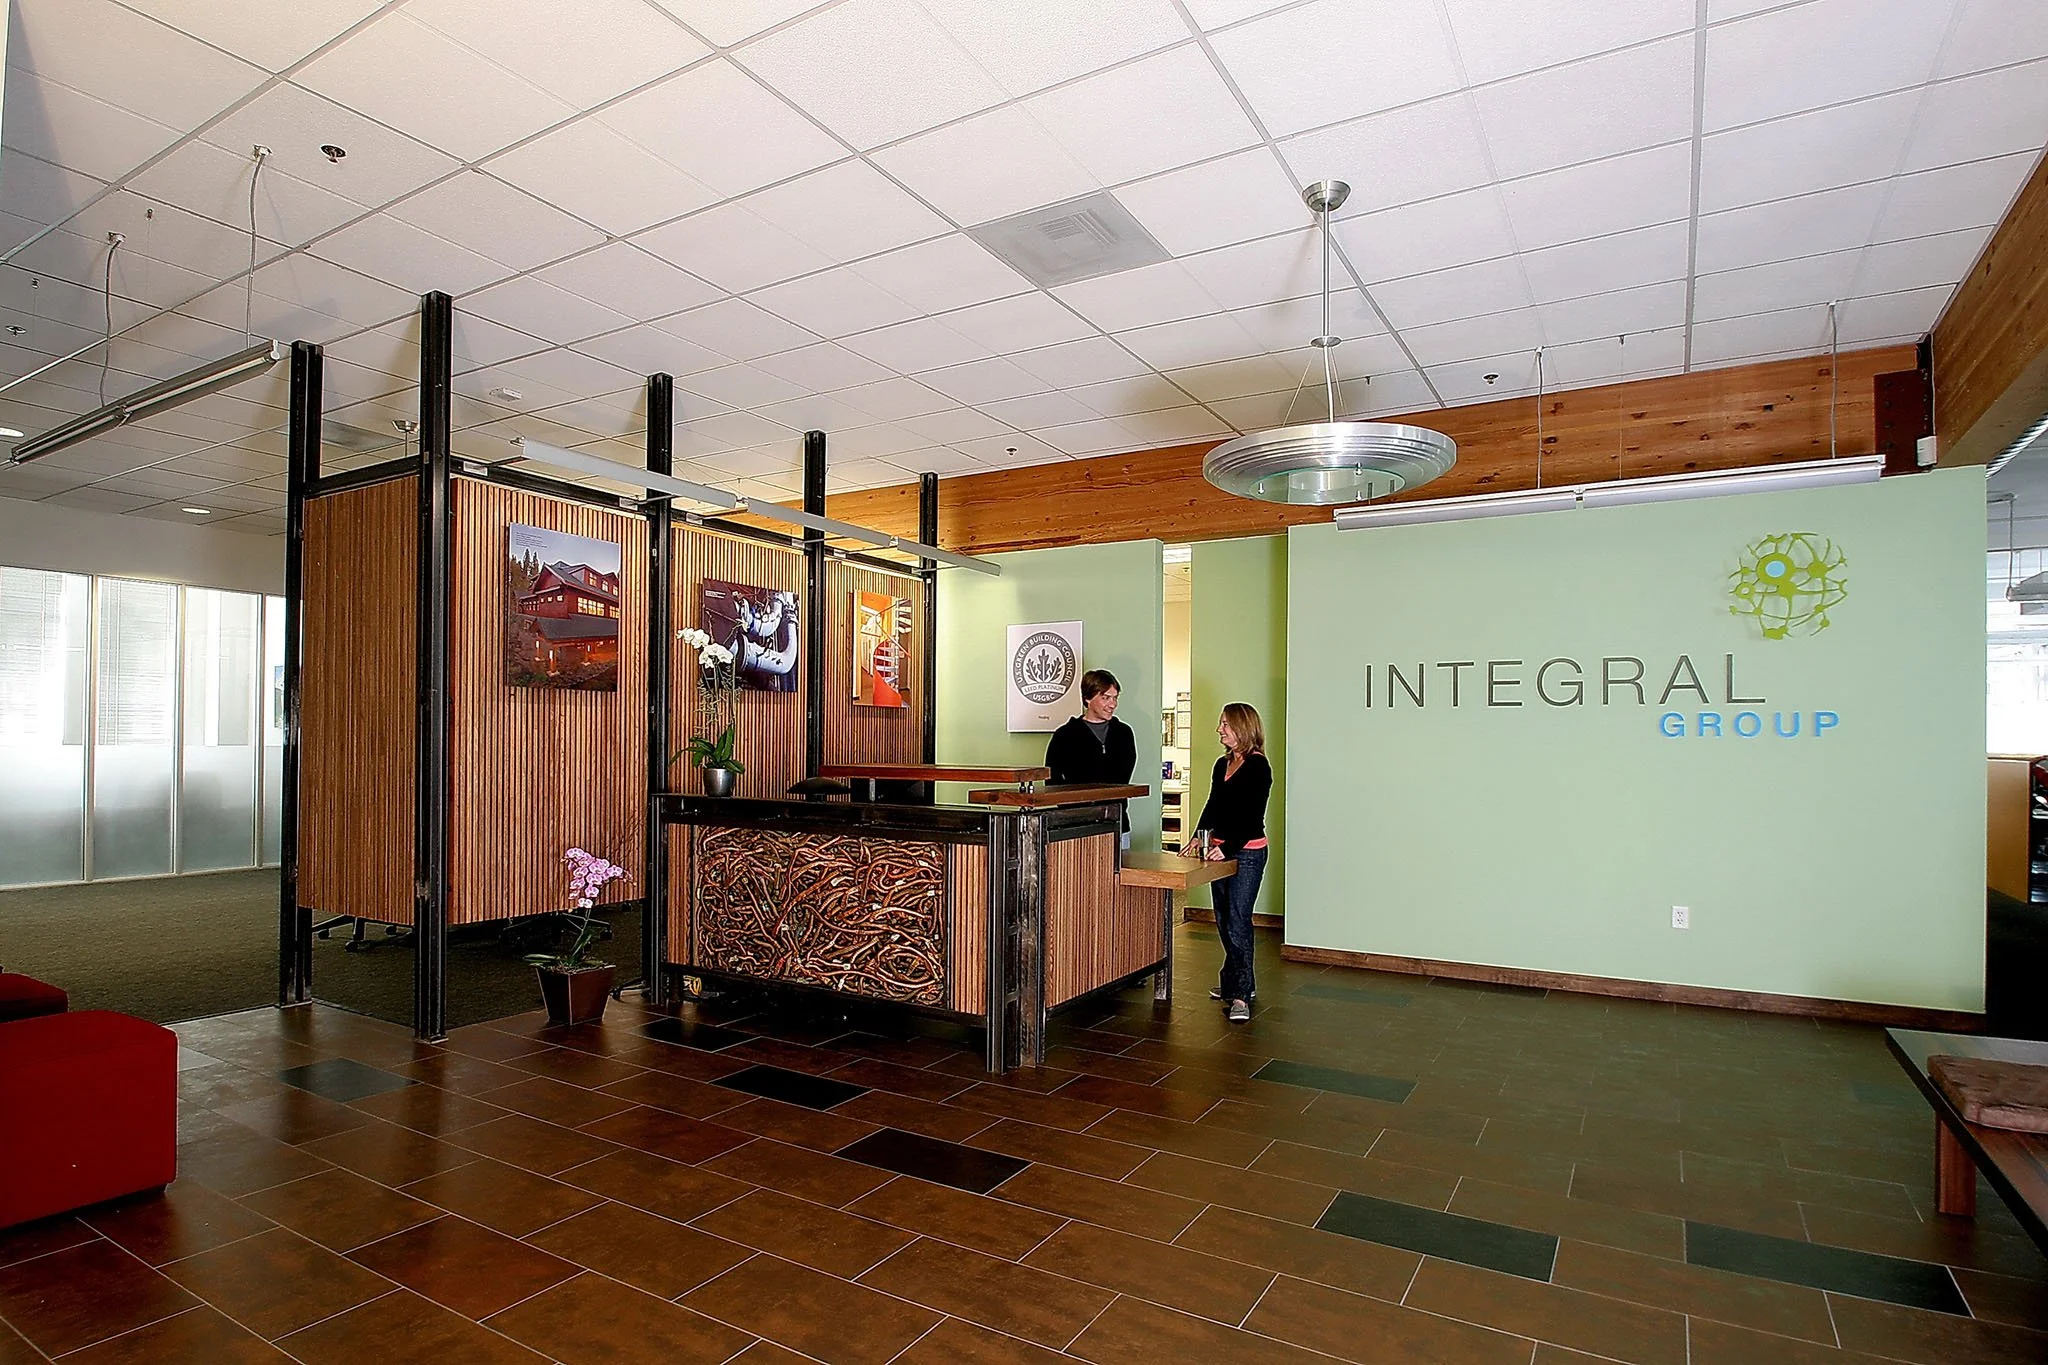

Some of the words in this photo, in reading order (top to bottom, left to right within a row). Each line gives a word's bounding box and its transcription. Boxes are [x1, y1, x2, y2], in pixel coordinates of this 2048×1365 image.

[1015, 643, 1029, 668] GREEN
[1029, 634, 1063, 646] BUILDING
[1062, 645, 1073, 682] COUNCIL
[1024, 685, 1037, 693] LEED
[1038, 684, 1064, 692] PLATINUM
[1365, 654, 1767, 708] INTEGRAL
[1033, 693, 1055, 701] USGBC
[1659, 711, 1840, 738] GROUP
